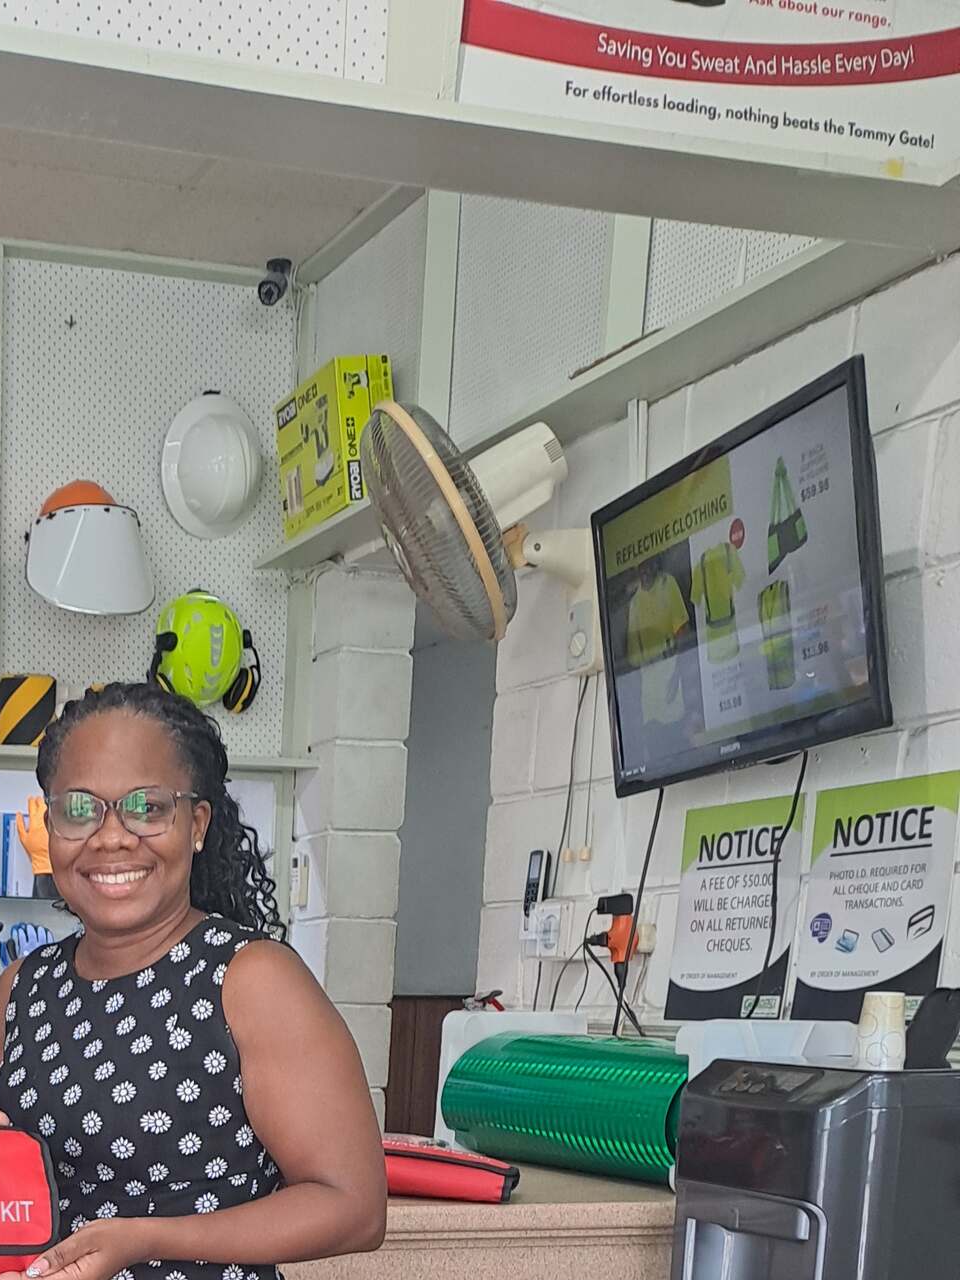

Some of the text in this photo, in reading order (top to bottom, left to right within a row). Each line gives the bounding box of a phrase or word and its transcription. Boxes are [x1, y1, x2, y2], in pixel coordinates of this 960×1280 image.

[778, 0, 817, 14] about
[822, 7, 844, 19] our
[848, 11, 891, 28] range.
[597, 32, 915, 76] Saving You Sweat And Hassle Every Day!
[565, 81, 935, 150] For effortless loading, nothing beats the Tommy Gate!
[616, 494, 728, 567] REFLECTIVE CLOTHING
[832, 805, 935, 849] NOTICE
[698, 826, 784, 863] NOTICE
[829, 868, 855, 880] PHOTO
[870, 864, 909, 877] REQUIRED
[910, 863, 927, 874] FOR
[700, 878, 707, 891] A
[709, 876, 725, 891] FEE
[727, 875, 740, 889] OF
[832, 878, 924, 896] ALL CHEQUE AND CARD
[693, 894, 774, 912] WILL BE CHARGE
[845, 896, 904, 911] TRANSACTIONS.
[690, 919, 705, 933] ON
[706, 917, 723, 932] ALL
[706, 937, 753, 952] CHEQUES.
[0, 1200, 34, 1223] KIT
